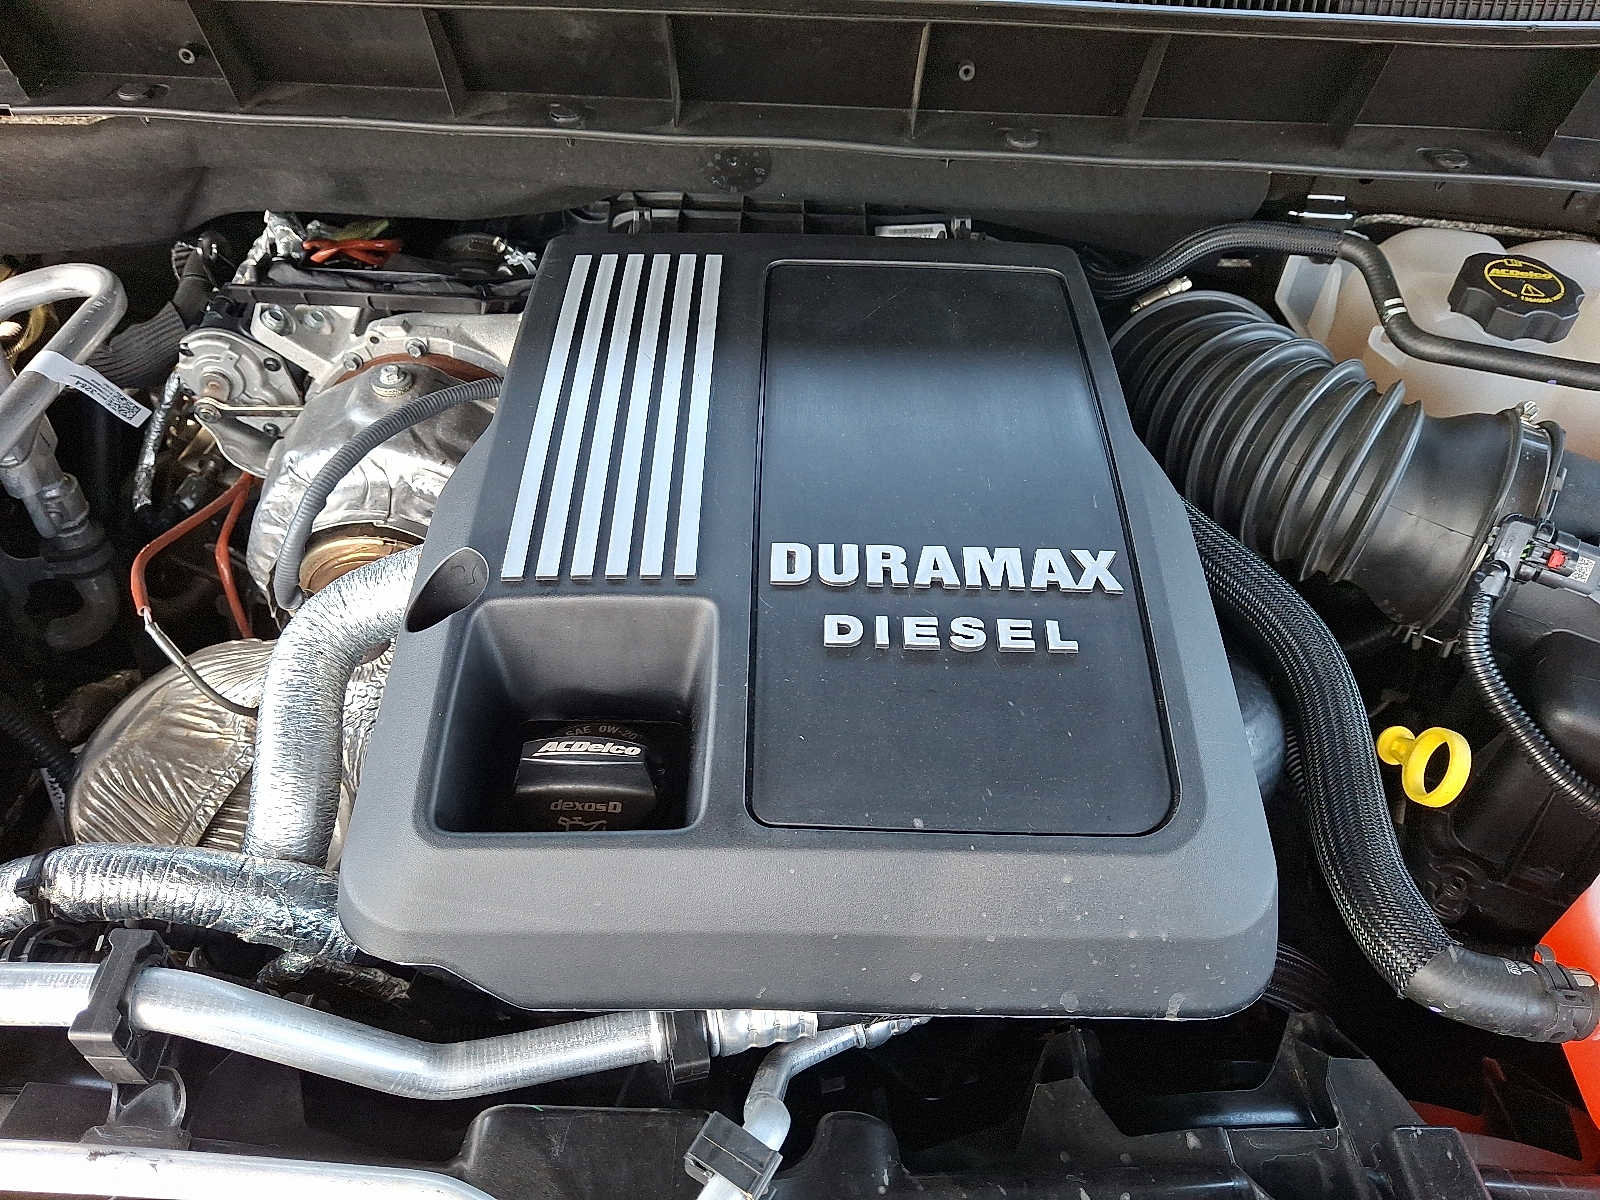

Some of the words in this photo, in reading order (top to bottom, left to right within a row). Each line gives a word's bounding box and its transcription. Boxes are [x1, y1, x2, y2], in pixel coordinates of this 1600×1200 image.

[769, 542, 1125, 595] DURAMAX
[823, 613, 1080, 654] DIESEL
[537, 741, 642, 756] ACDelco
